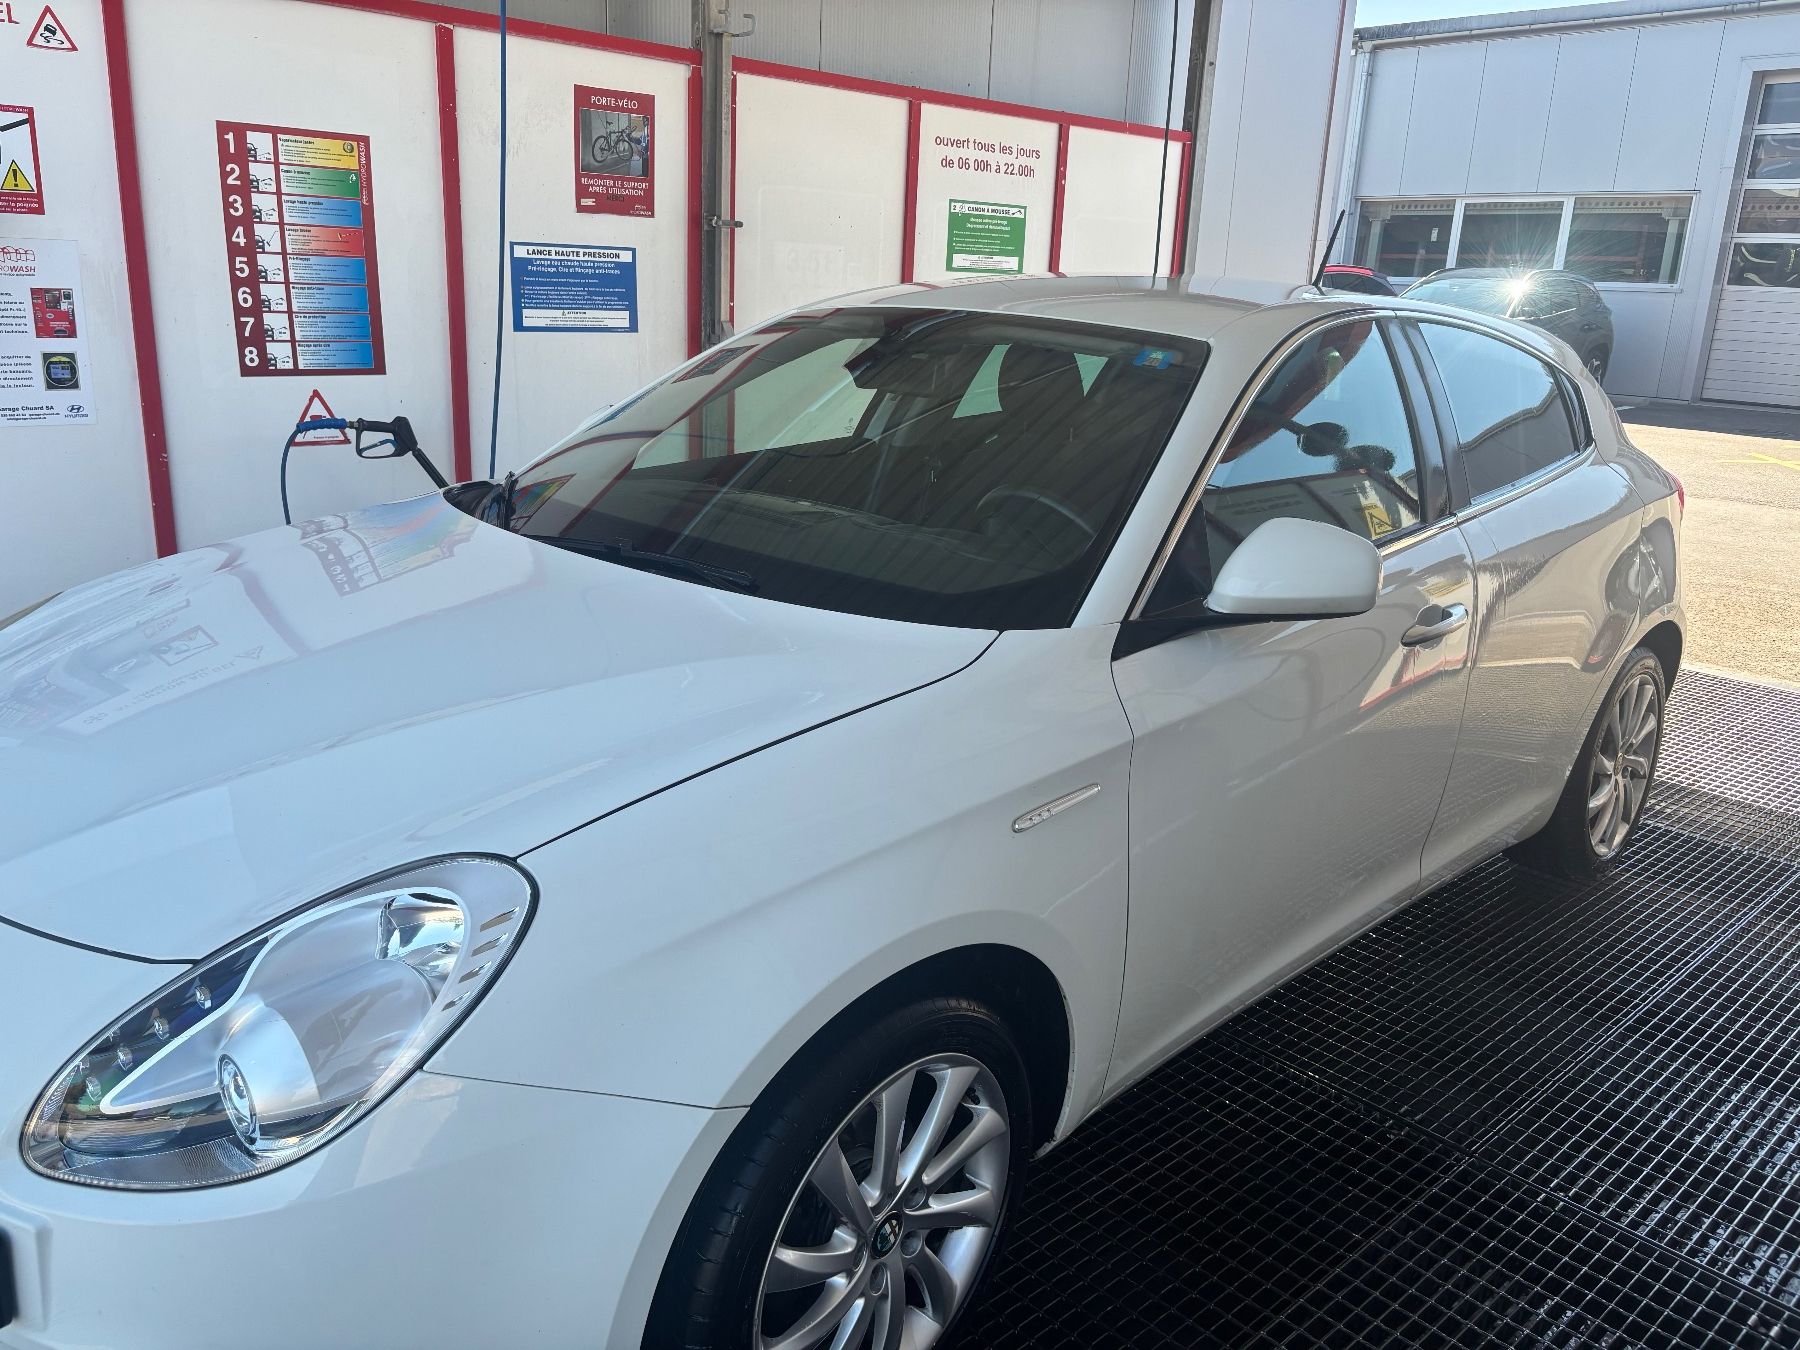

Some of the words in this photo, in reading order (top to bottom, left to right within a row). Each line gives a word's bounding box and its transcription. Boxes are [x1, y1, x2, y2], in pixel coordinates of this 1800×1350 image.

[591, 95, 638, 109] PORTE-VÉLO
[224, 131, 235, 154] 1
[934, 135, 970, 149] ouvert
[973, 139, 996, 153] tous
[999, 141, 1013, 156] les
[1015, 144, 1041, 160] jours
[225, 163, 241, 185] 2
[941, 155, 955, 168] de
[957, 157, 971, 170] 06
[973, 158, 992, 173] 00h
[995, 161, 1001, 174] à
[1004, 162, 1035, 178] 22.00h
[581, 178, 614, 187] REMONTER
[623, 181, 649, 189] SUPPORT
[608, 187, 644, 196] UTILISATION
[228, 194, 244, 217] 3
[990, 208, 1011, 216] MOUSSE
[231, 226, 247, 247] 4
[526, 248, 553, 257] LANCE
[554, 249, 581, 258] HAUTE
[582, 250, 620, 259] PRESSION
[235, 256, 250, 278] 5
[237, 286, 253, 308] 6
[240, 317, 255, 337] 7
[244, 346, 260, 367] 8
